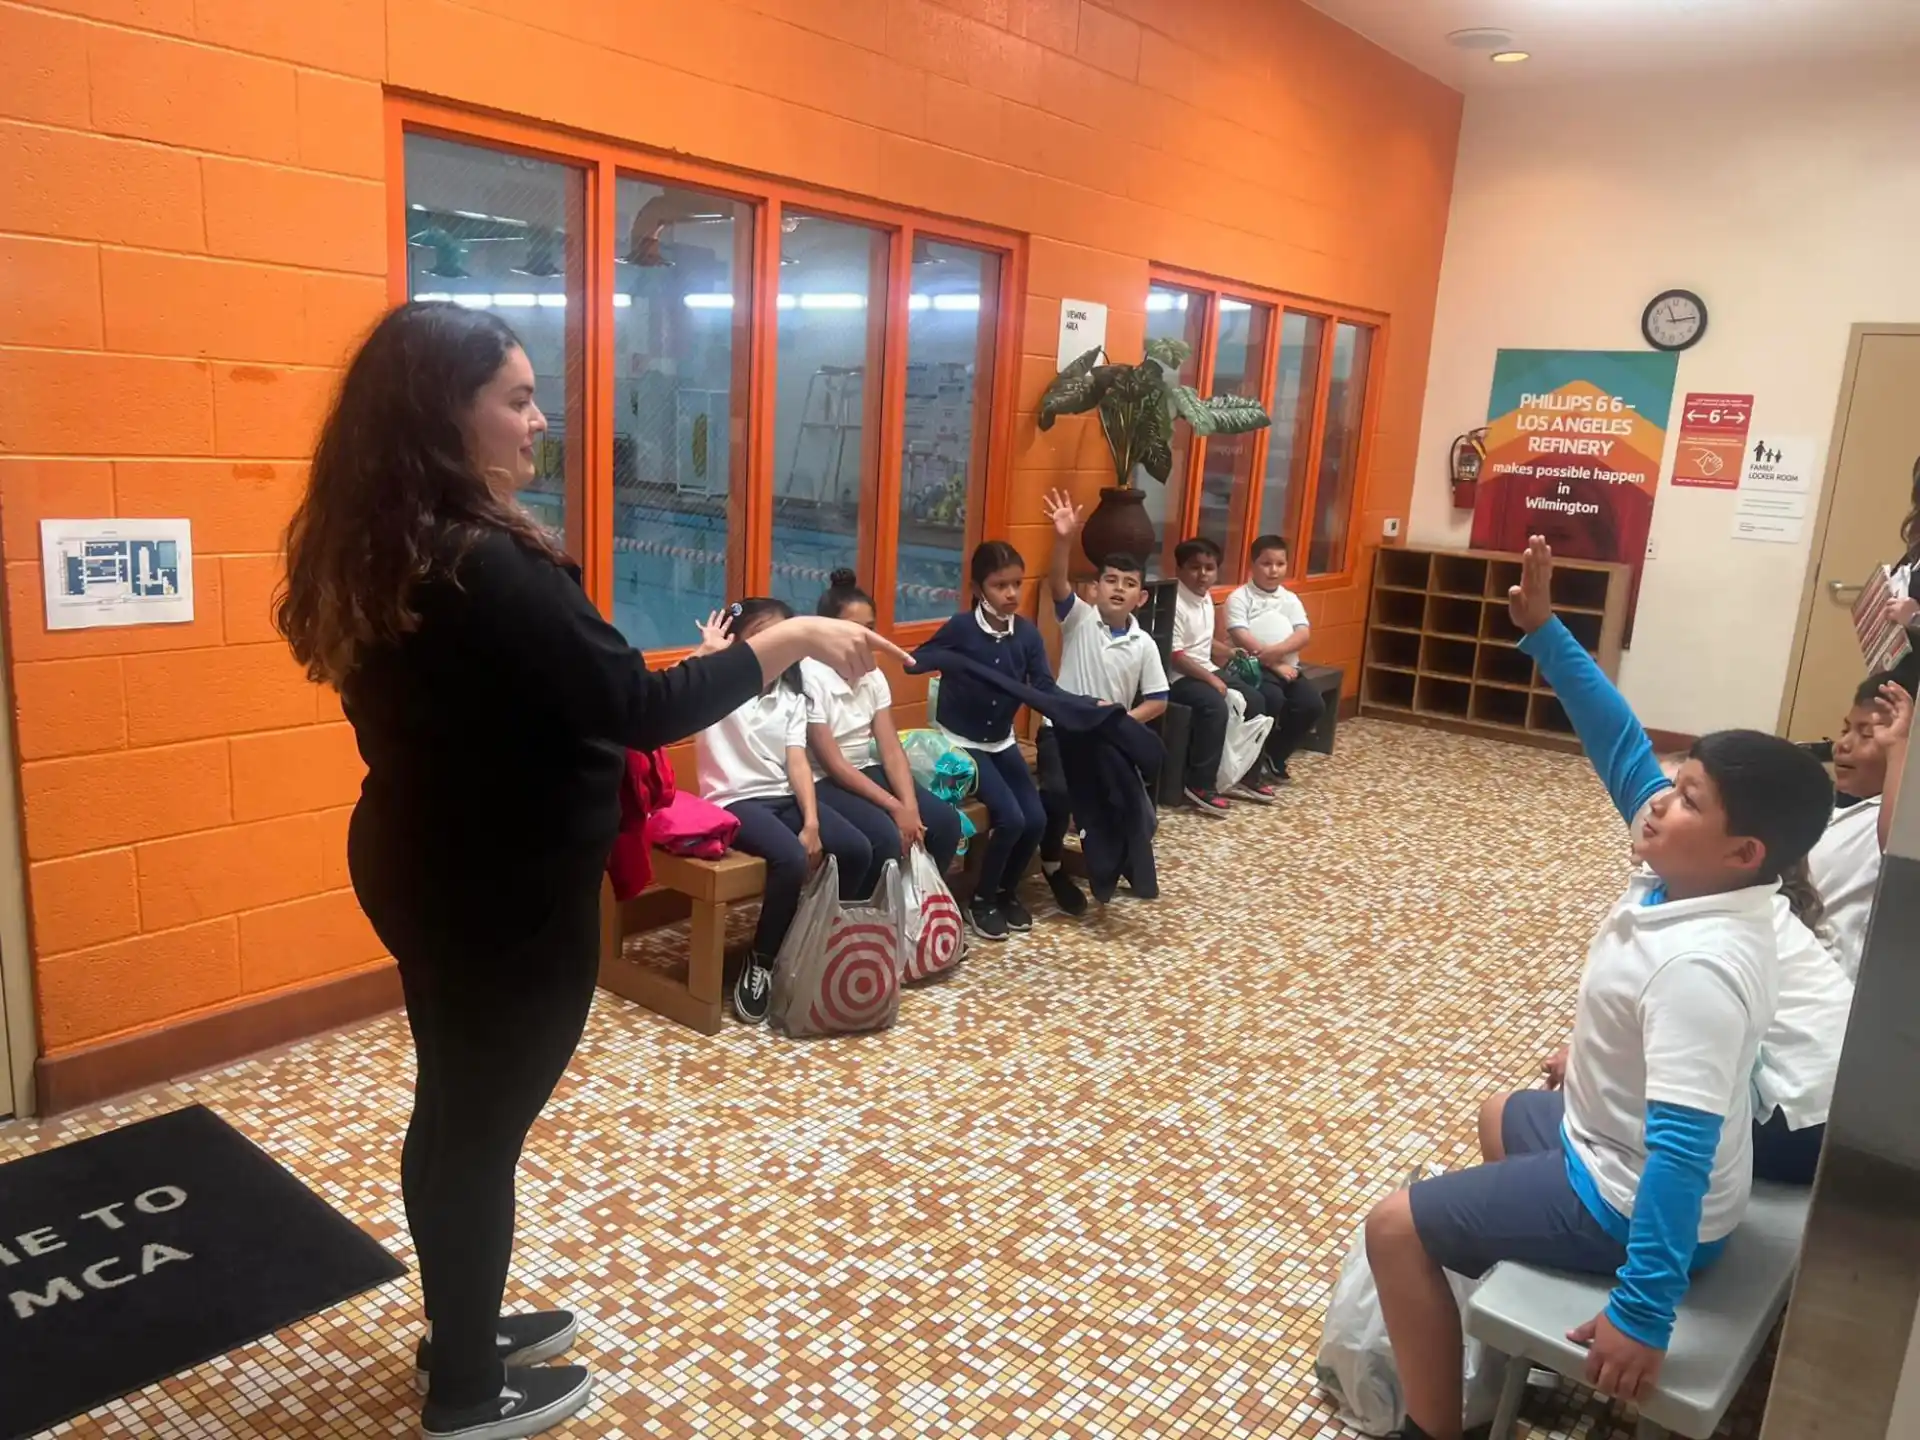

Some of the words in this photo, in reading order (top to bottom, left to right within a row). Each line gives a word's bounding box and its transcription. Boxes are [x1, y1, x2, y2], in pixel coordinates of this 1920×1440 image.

[1066, 310, 1087, 321] VIEWING
[1065, 322, 1079, 331] AREA
[1519, 393, 1592, 412] PHILLIPS
[1516, 415, 1548, 431] LOS
[1550, 417, 1633, 435] ANGELES
[1528, 436, 1614, 456] REFINERY
[1492, 462, 1533, 475] makes
[1536, 464, 1591, 479] possible
[1593, 468, 1645, 484] happen
[1748, 472, 1775, 481] LOCKER
[1776, 474, 1799, 482] ROOM
[1750, 464, 1774, 472] FAMILY
[1557, 482, 1571, 494] in
[1525, 496, 1599, 515] Wilmington
[79, 1185, 188, 1230] TO
[9, 1243, 194, 1319] MCA
